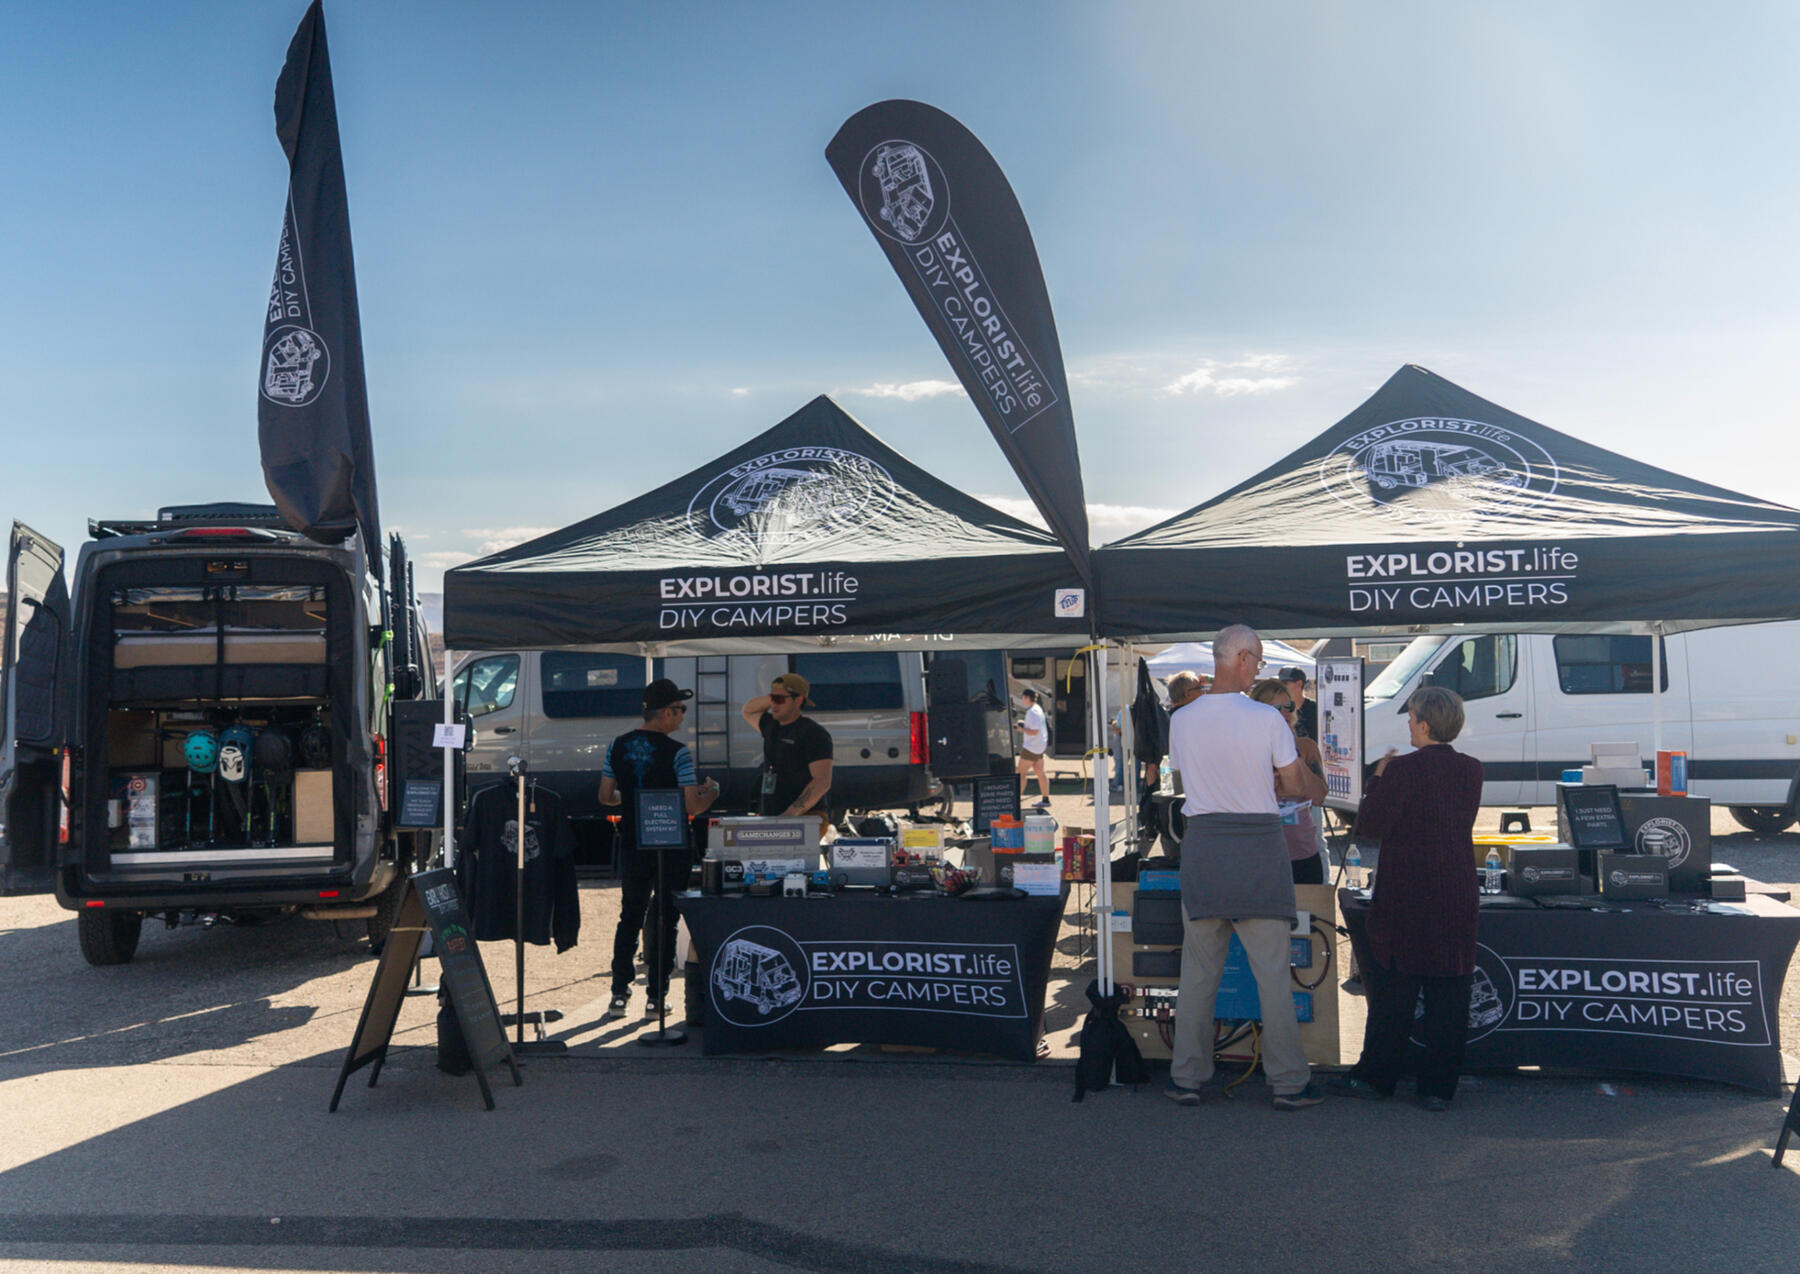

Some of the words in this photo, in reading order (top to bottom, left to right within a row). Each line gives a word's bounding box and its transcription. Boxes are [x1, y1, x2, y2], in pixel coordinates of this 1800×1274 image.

[285, 291, 301, 318] DIY
[916, 246, 950, 288] DIY
[944, 296, 1018, 416] CAMPERS
[936, 231, 1042, 408] EXPLORIST.life
[1345, 418, 1512, 452] EXPLORIST.life
[1346, 546, 1579, 579] EXPLORIST.life
[659, 571, 860, 600] EXPLORIST.life
[1348, 587, 1401, 612] DIY
[1409, 582, 1569, 609] CAMPERS
[659, 606, 704, 630] DIY
[711, 603, 848, 627] CAMPERS
[812, 950, 1012, 976] EXPLORIST.life
[813, 980, 863, 1000] DIY
[867, 981, 1007, 1007] CAMPERS
[1518, 969, 1753, 997] EXPLORIST.life
[1517, 1000, 1573, 1022] DIY
[1582, 1002, 1746, 1033] CAMPERS
